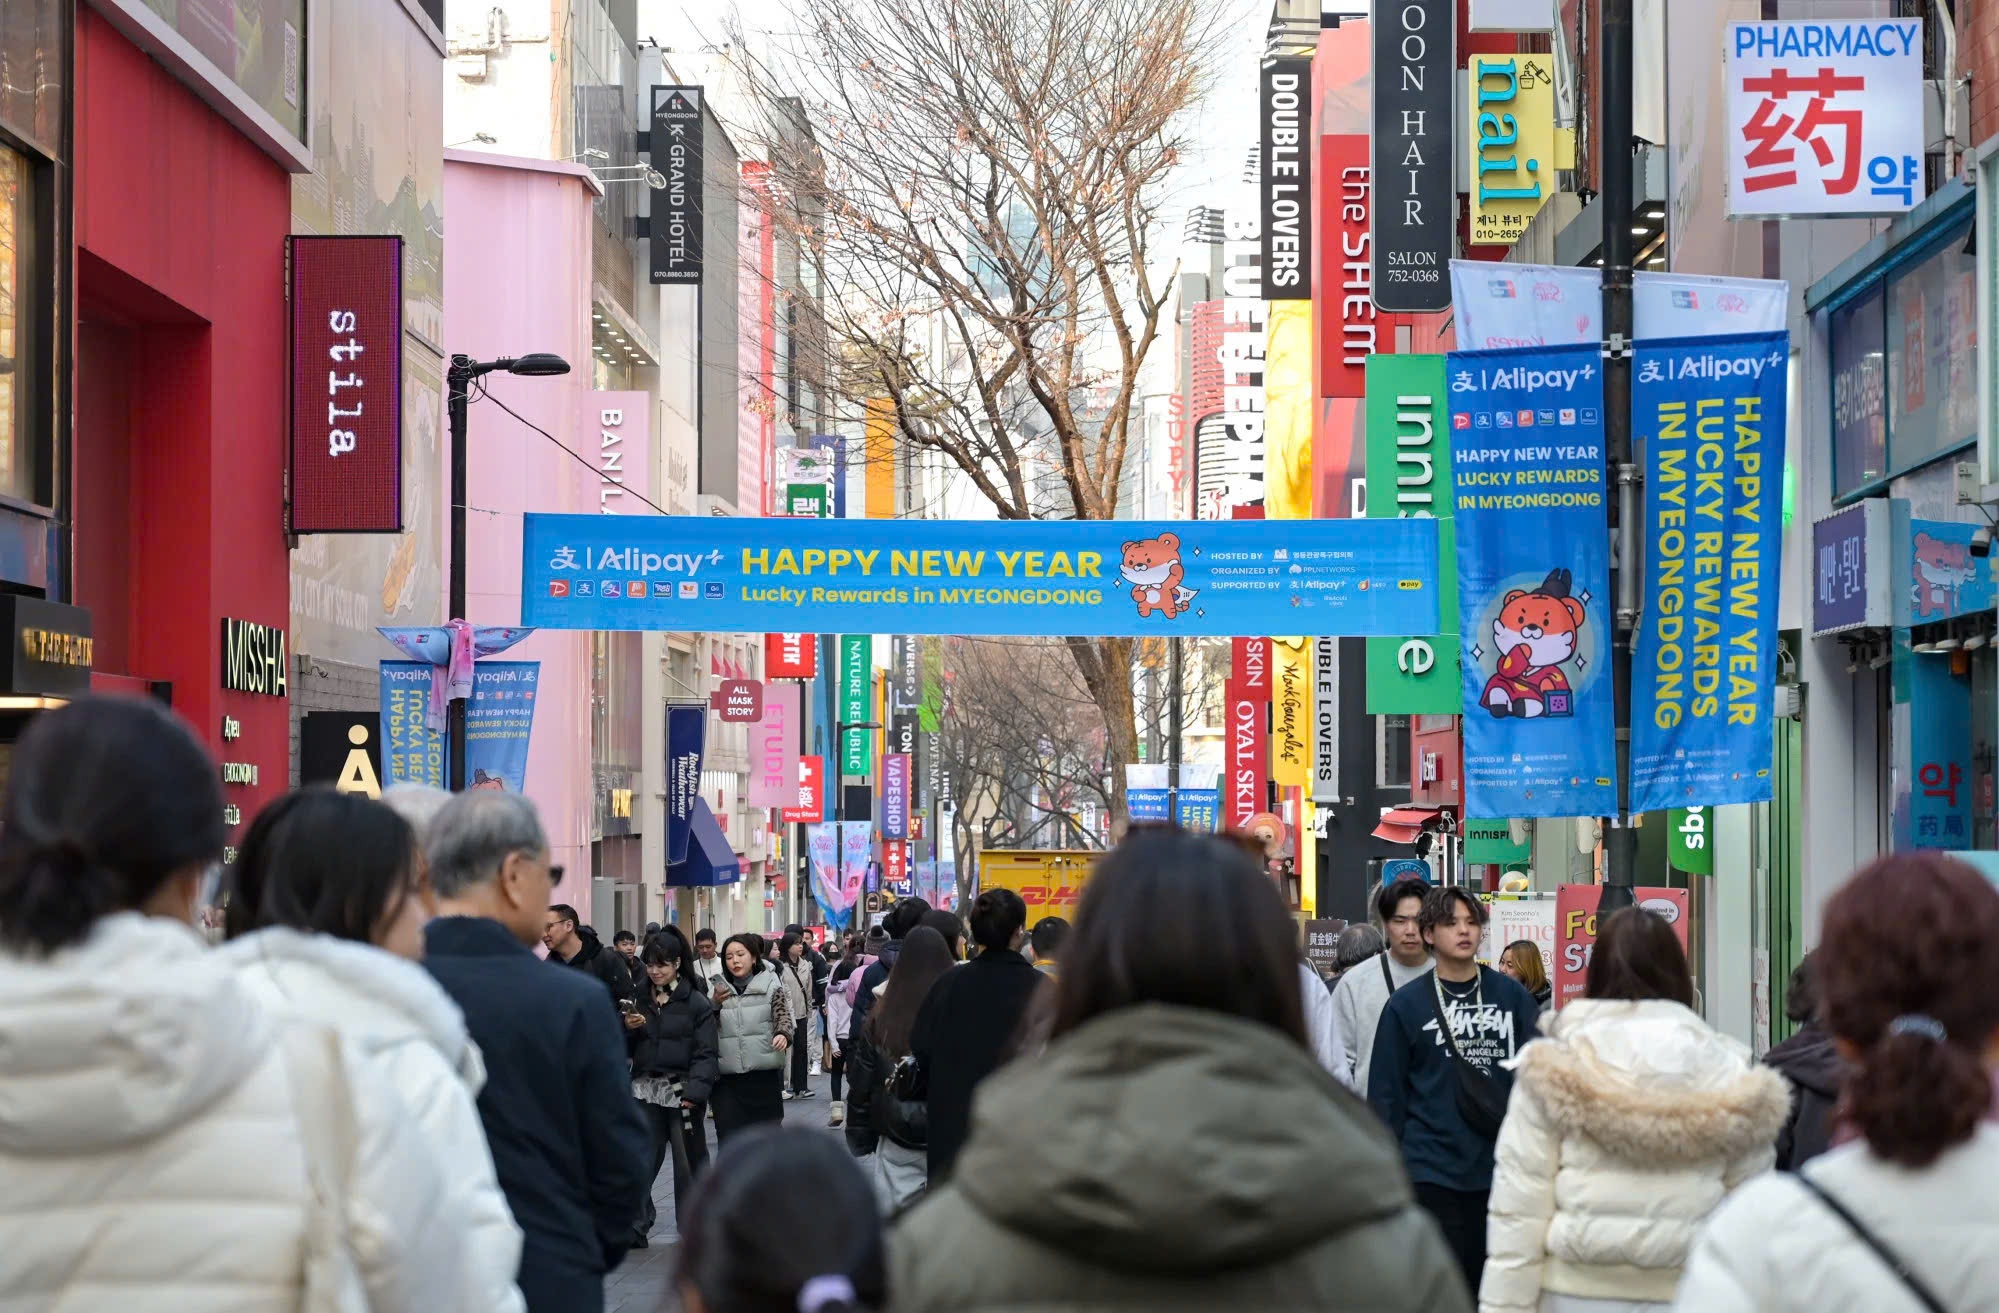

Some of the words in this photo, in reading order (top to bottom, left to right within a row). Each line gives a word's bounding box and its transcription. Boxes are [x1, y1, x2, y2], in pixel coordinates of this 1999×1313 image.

[1736, 24, 1918, 58] PHARMACY
[1272, 74, 1299, 177] DOUBLE
[1477, 58, 1541, 208] nail
[1742, 67, 1864, 195] 药
[670, 123, 685, 206] K-GRAND
[1401, 110, 1426, 226] HAIR
[1867, 156, 1918, 206] 약
[669, 212, 684, 268] HOTEL
[1272, 185, 1299, 287] LOVERS
[1476, 214, 1497, 226] 제니
[1501, 214, 1522, 226] 뷰티
[1223, 210, 1263, 325] BLUE
[1388, 251, 1437, 266] SALON
[1388, 269, 1439, 284] 752-0368
[328, 310, 363, 457] stila
[1657, 401, 1687, 440] IN
[1455, 447, 1510, 463] HAPPY
[1513, 446, 1552, 462] NEW
[1556, 445, 1599, 460] YEAR
[1457, 471, 1512, 486] LUCKY
[1516, 469, 1600, 485] REWARDS
[1695, 398, 1724, 523] LUCKY
[1731, 397, 1761, 523] HAPPY
[1458, 495, 1477, 509] IN
[1479, 492, 1601, 509] MYEONGDONG
[742, 548, 880, 576] HAPPY
[890, 550, 985, 578] NEW
[995, 551, 1102, 579] YEAR
[1211, 552, 1249, 560] HOSTED
[1250, 552, 1263, 560] BY
[1211, 567, 1266, 575] ORGANIZED
[1267, 567, 1280, 575] BY
[1729, 536, 1760, 619] NEW
[742, 586, 806, 606] Lucky
[812, 586, 908, 605] Rewards
[914, 586, 934, 603] in
[940, 587, 1102, 606] MYEONGDONG
[1211, 581, 1266, 589] SUPPORTED
[1268, 581, 1280, 589] BY
[1654, 449, 1686, 729] MYEONGDONG
[1692, 531, 1723, 717] REWARDS
[228, 617, 287, 697] MISSHA
[850, 640, 861, 696] NATURE
[1246, 636, 1264, 687] SKIN
[1318, 636, 1332, 693] UBLE
[1728, 629, 1758, 726] YEAR
[727, 707, 754, 715] STORY
[728, 696, 753, 705] MASK
[733, 686, 749, 694] ALL
[764, 703, 784, 788] ETUDE
[1318, 700, 1332, 782] LOVERS
[687, 752, 699, 795] Rockfish
[888, 757, 901, 835] VAPESHOP
[1918, 762, 1962, 807] 약
[1467, 1048, 1505, 1057] ANGELES
